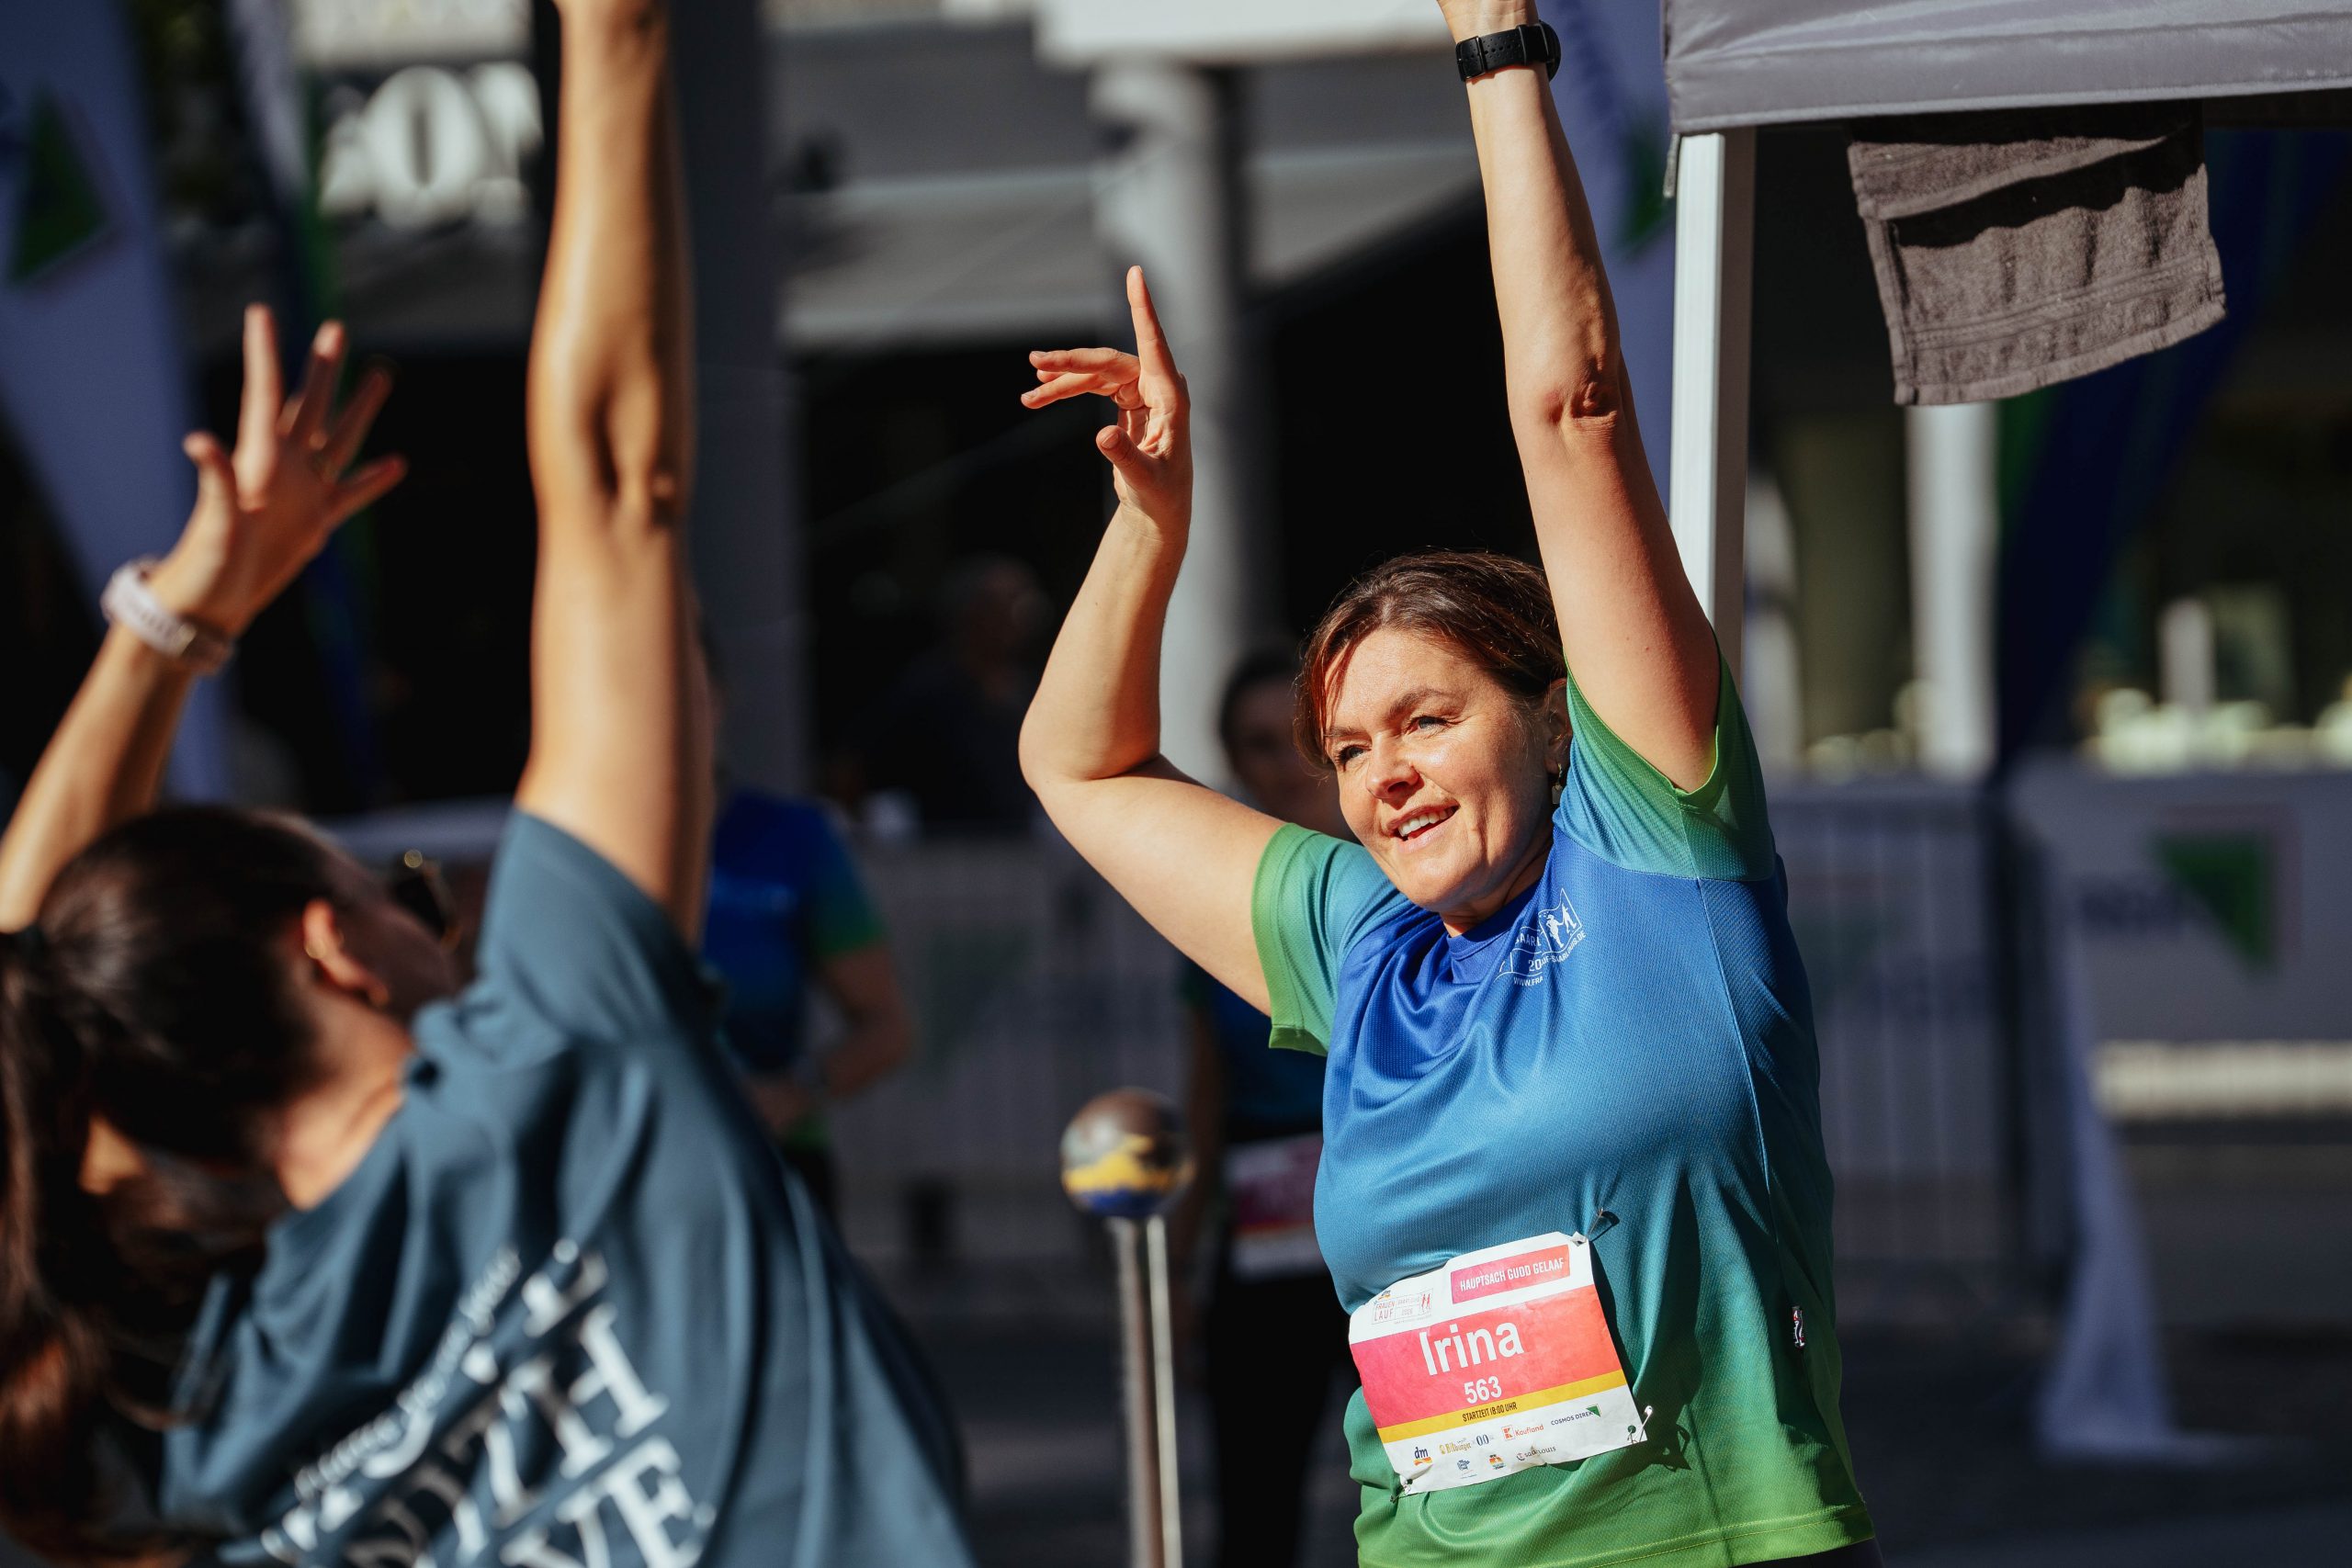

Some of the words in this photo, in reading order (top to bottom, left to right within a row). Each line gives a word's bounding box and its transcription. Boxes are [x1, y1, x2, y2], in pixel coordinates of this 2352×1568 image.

[1460, 1271, 1507, 1292] HAUPTSACH
[1532, 1257, 1565, 1274] GELAAF
[1374, 1308, 1395, 1321] LAUF
[1419, 1322, 1525, 1376] Irina
[1464, 1375, 1502, 1404] 563
[1462, 1407, 1490, 1423] STARTZEIT
[1489, 1404, 1505, 1416] 18:00
[1504, 1401, 1518, 1413] UHR
[1550, 1415, 1575, 1426] COSMOS
[1514, 1424, 1544, 1437] Kaufland
[1414, 1446, 1429, 1460] dm
